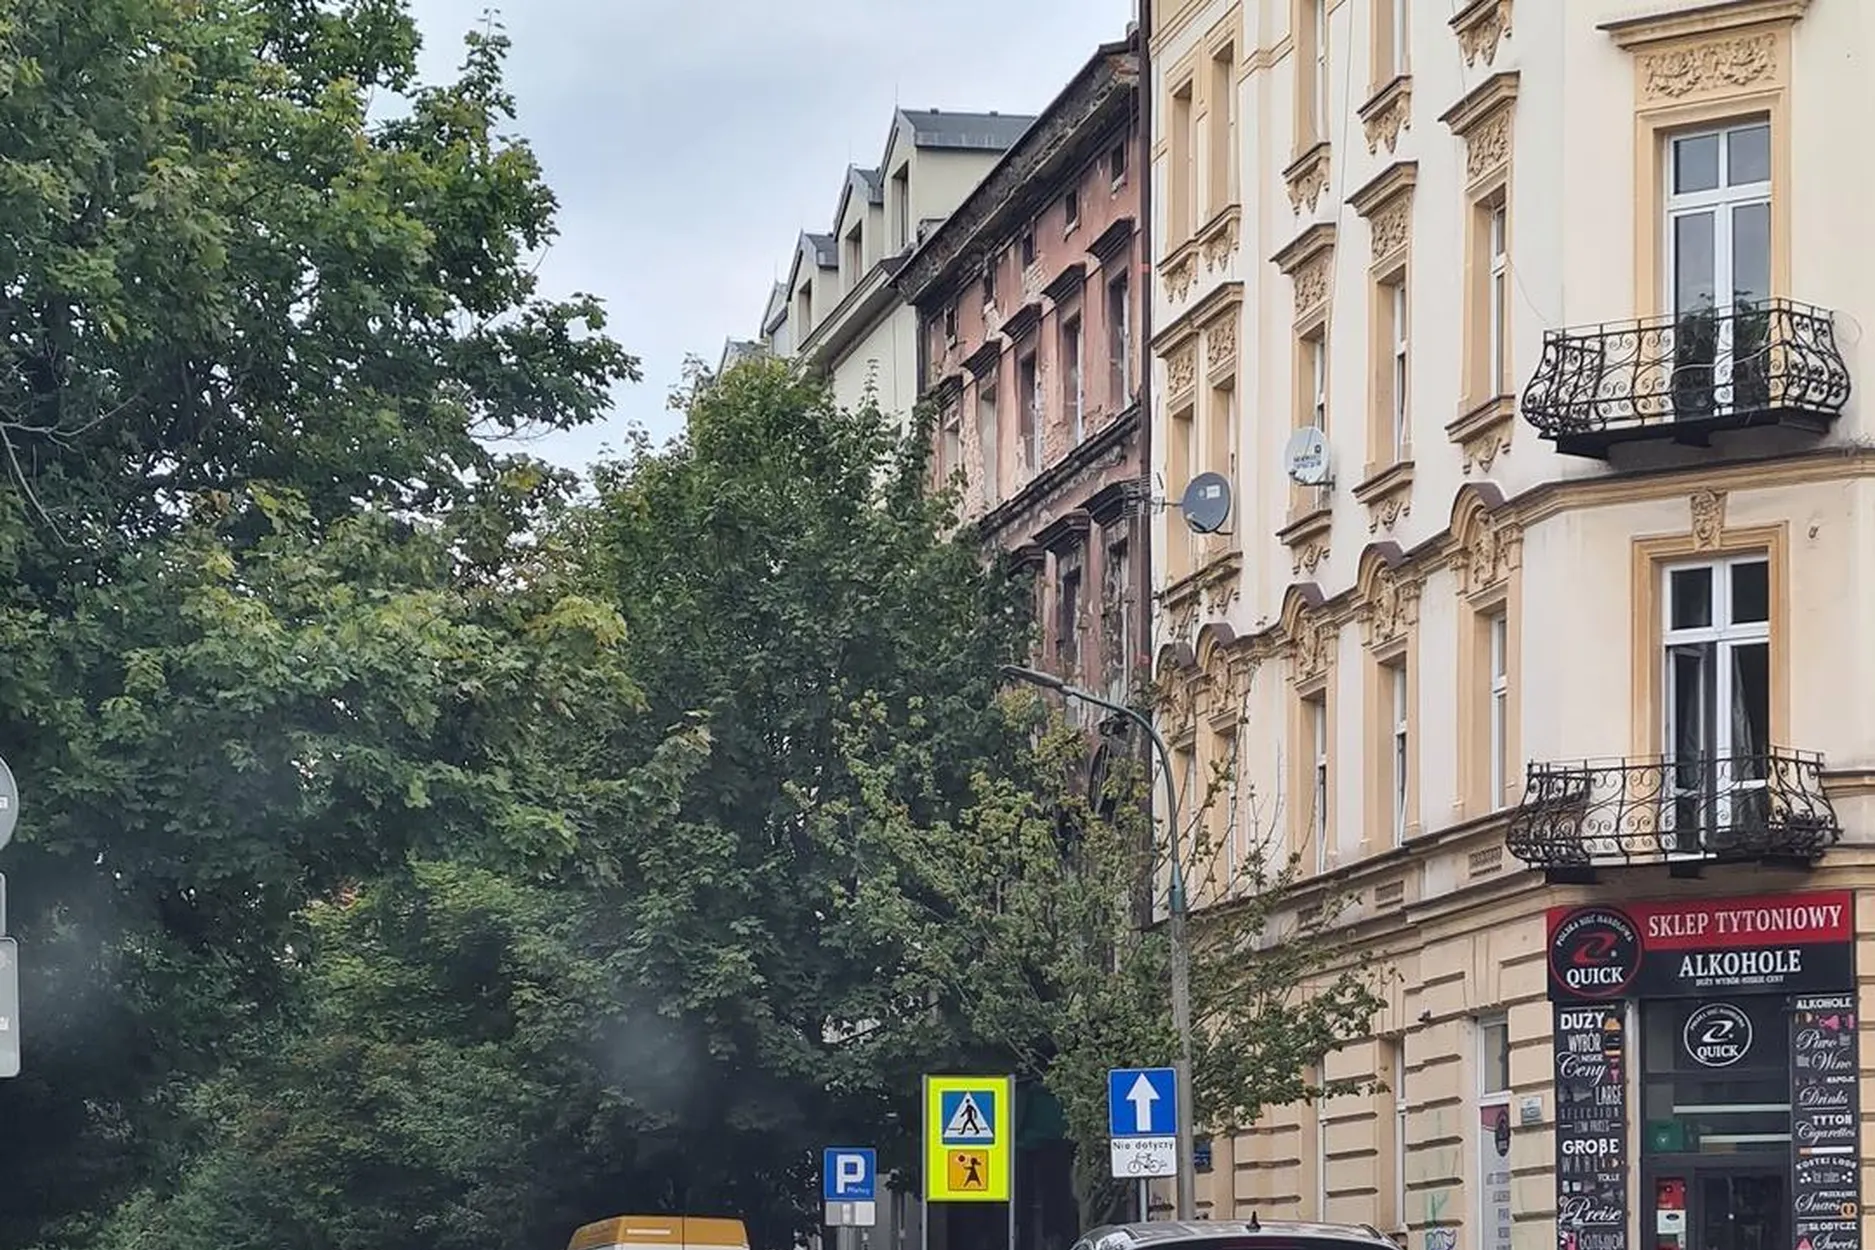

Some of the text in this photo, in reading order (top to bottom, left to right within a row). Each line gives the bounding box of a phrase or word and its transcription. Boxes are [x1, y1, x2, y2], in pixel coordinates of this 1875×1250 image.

[1648, 905, 1843, 937] SKLEP TYTONIOWY
[1566, 966, 1624, 989] QUICK
[1678, 950, 1802, 978] ALKOHOLE
[1796, 997, 1852, 1009] ALKOHOLE
[1697, 1044, 1740, 1061] QUICK
[1556, 1051, 1607, 1087] Ceny
[836, 1154, 865, 1194] P
[1559, 1195, 1622, 1221] Preise
